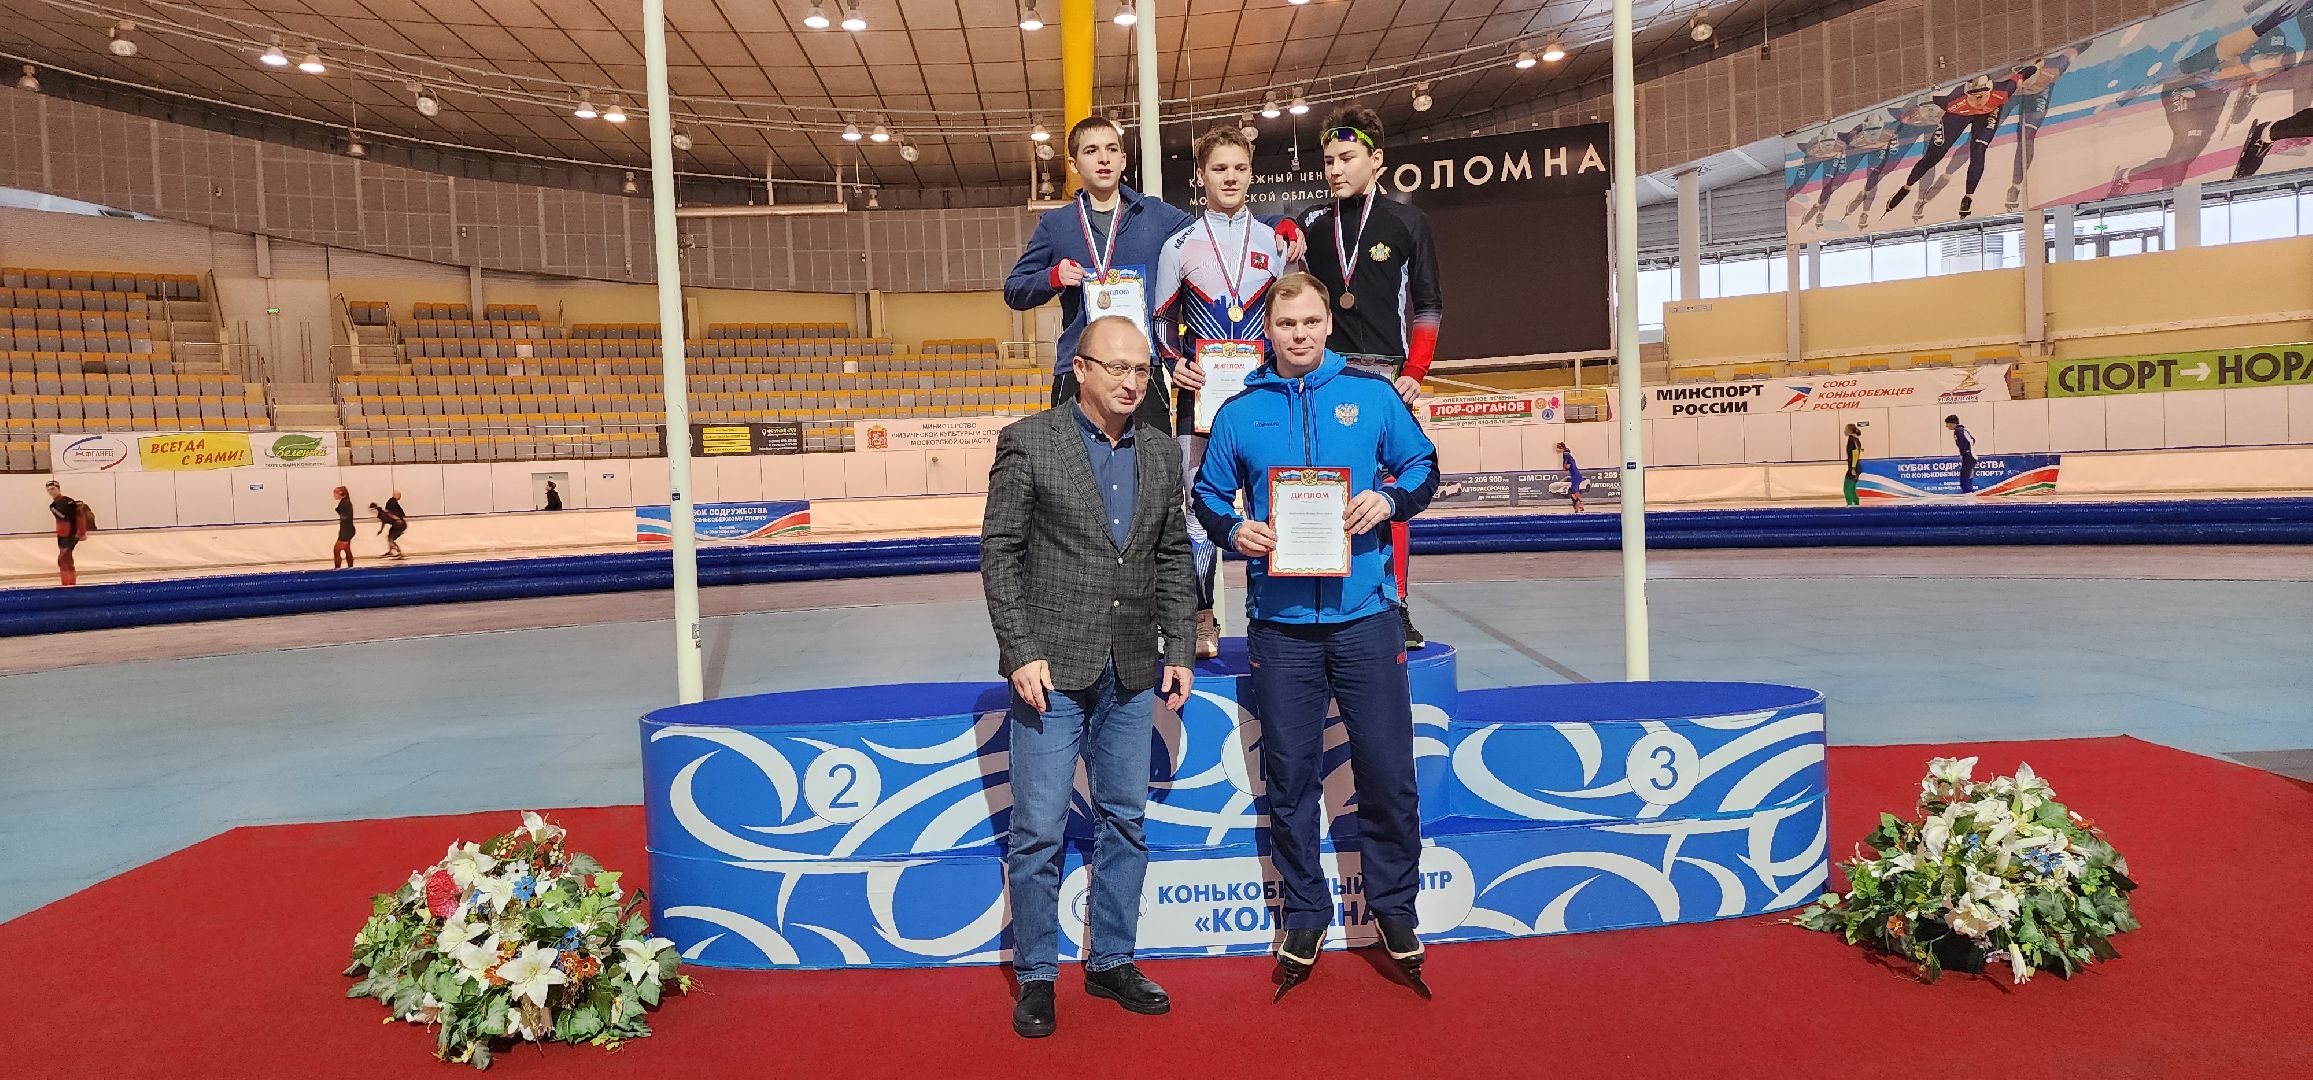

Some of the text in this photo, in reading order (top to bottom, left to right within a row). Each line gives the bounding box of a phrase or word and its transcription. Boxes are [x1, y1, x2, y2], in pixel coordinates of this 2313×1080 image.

[1189, 171, 1324, 189] КОЕЖНЫЙ ЦЕН
[1190, 191, 1276, 206] МОСКОЙ
[2058, 359, 2178, 392] СПОРТ
[1822, 379, 1858, 389] СОЮЗ
[1656, 384, 1764, 401] МИНСПОРТ
[1817, 387, 1915, 400] КОНЬКОБЕЖЦЕВ
[1435, 401, 1526, 416] ЛОР-ОРГАНОВ
[1672, 400, 1748, 416] РОССИИ
[1812, 400, 1861, 411] РОССИИ
[922, 422, 977, 430] МИНИСТЕРСТВО
[891, 431, 939, 439] ФИЗИЧЕСКОЙ
[150, 438, 205, 454] ВСЕГДА
[181, 450, 245, 465] С ВАМИ!
[1898, 461, 2005, 471] КУБОК СОДРУЕСТВА
[1518, 474, 1558, 482] OMODA
[1290, 492, 1329, 500] ДИПЛОМ
[693, 507, 768, 516] БОК СОДРУЖЕСТВА
[1650, 745, 1679, 791] 3
[828, 763, 859, 809] 2
[1158, 872, 1366, 905] КОНЬКОБЫЙ
